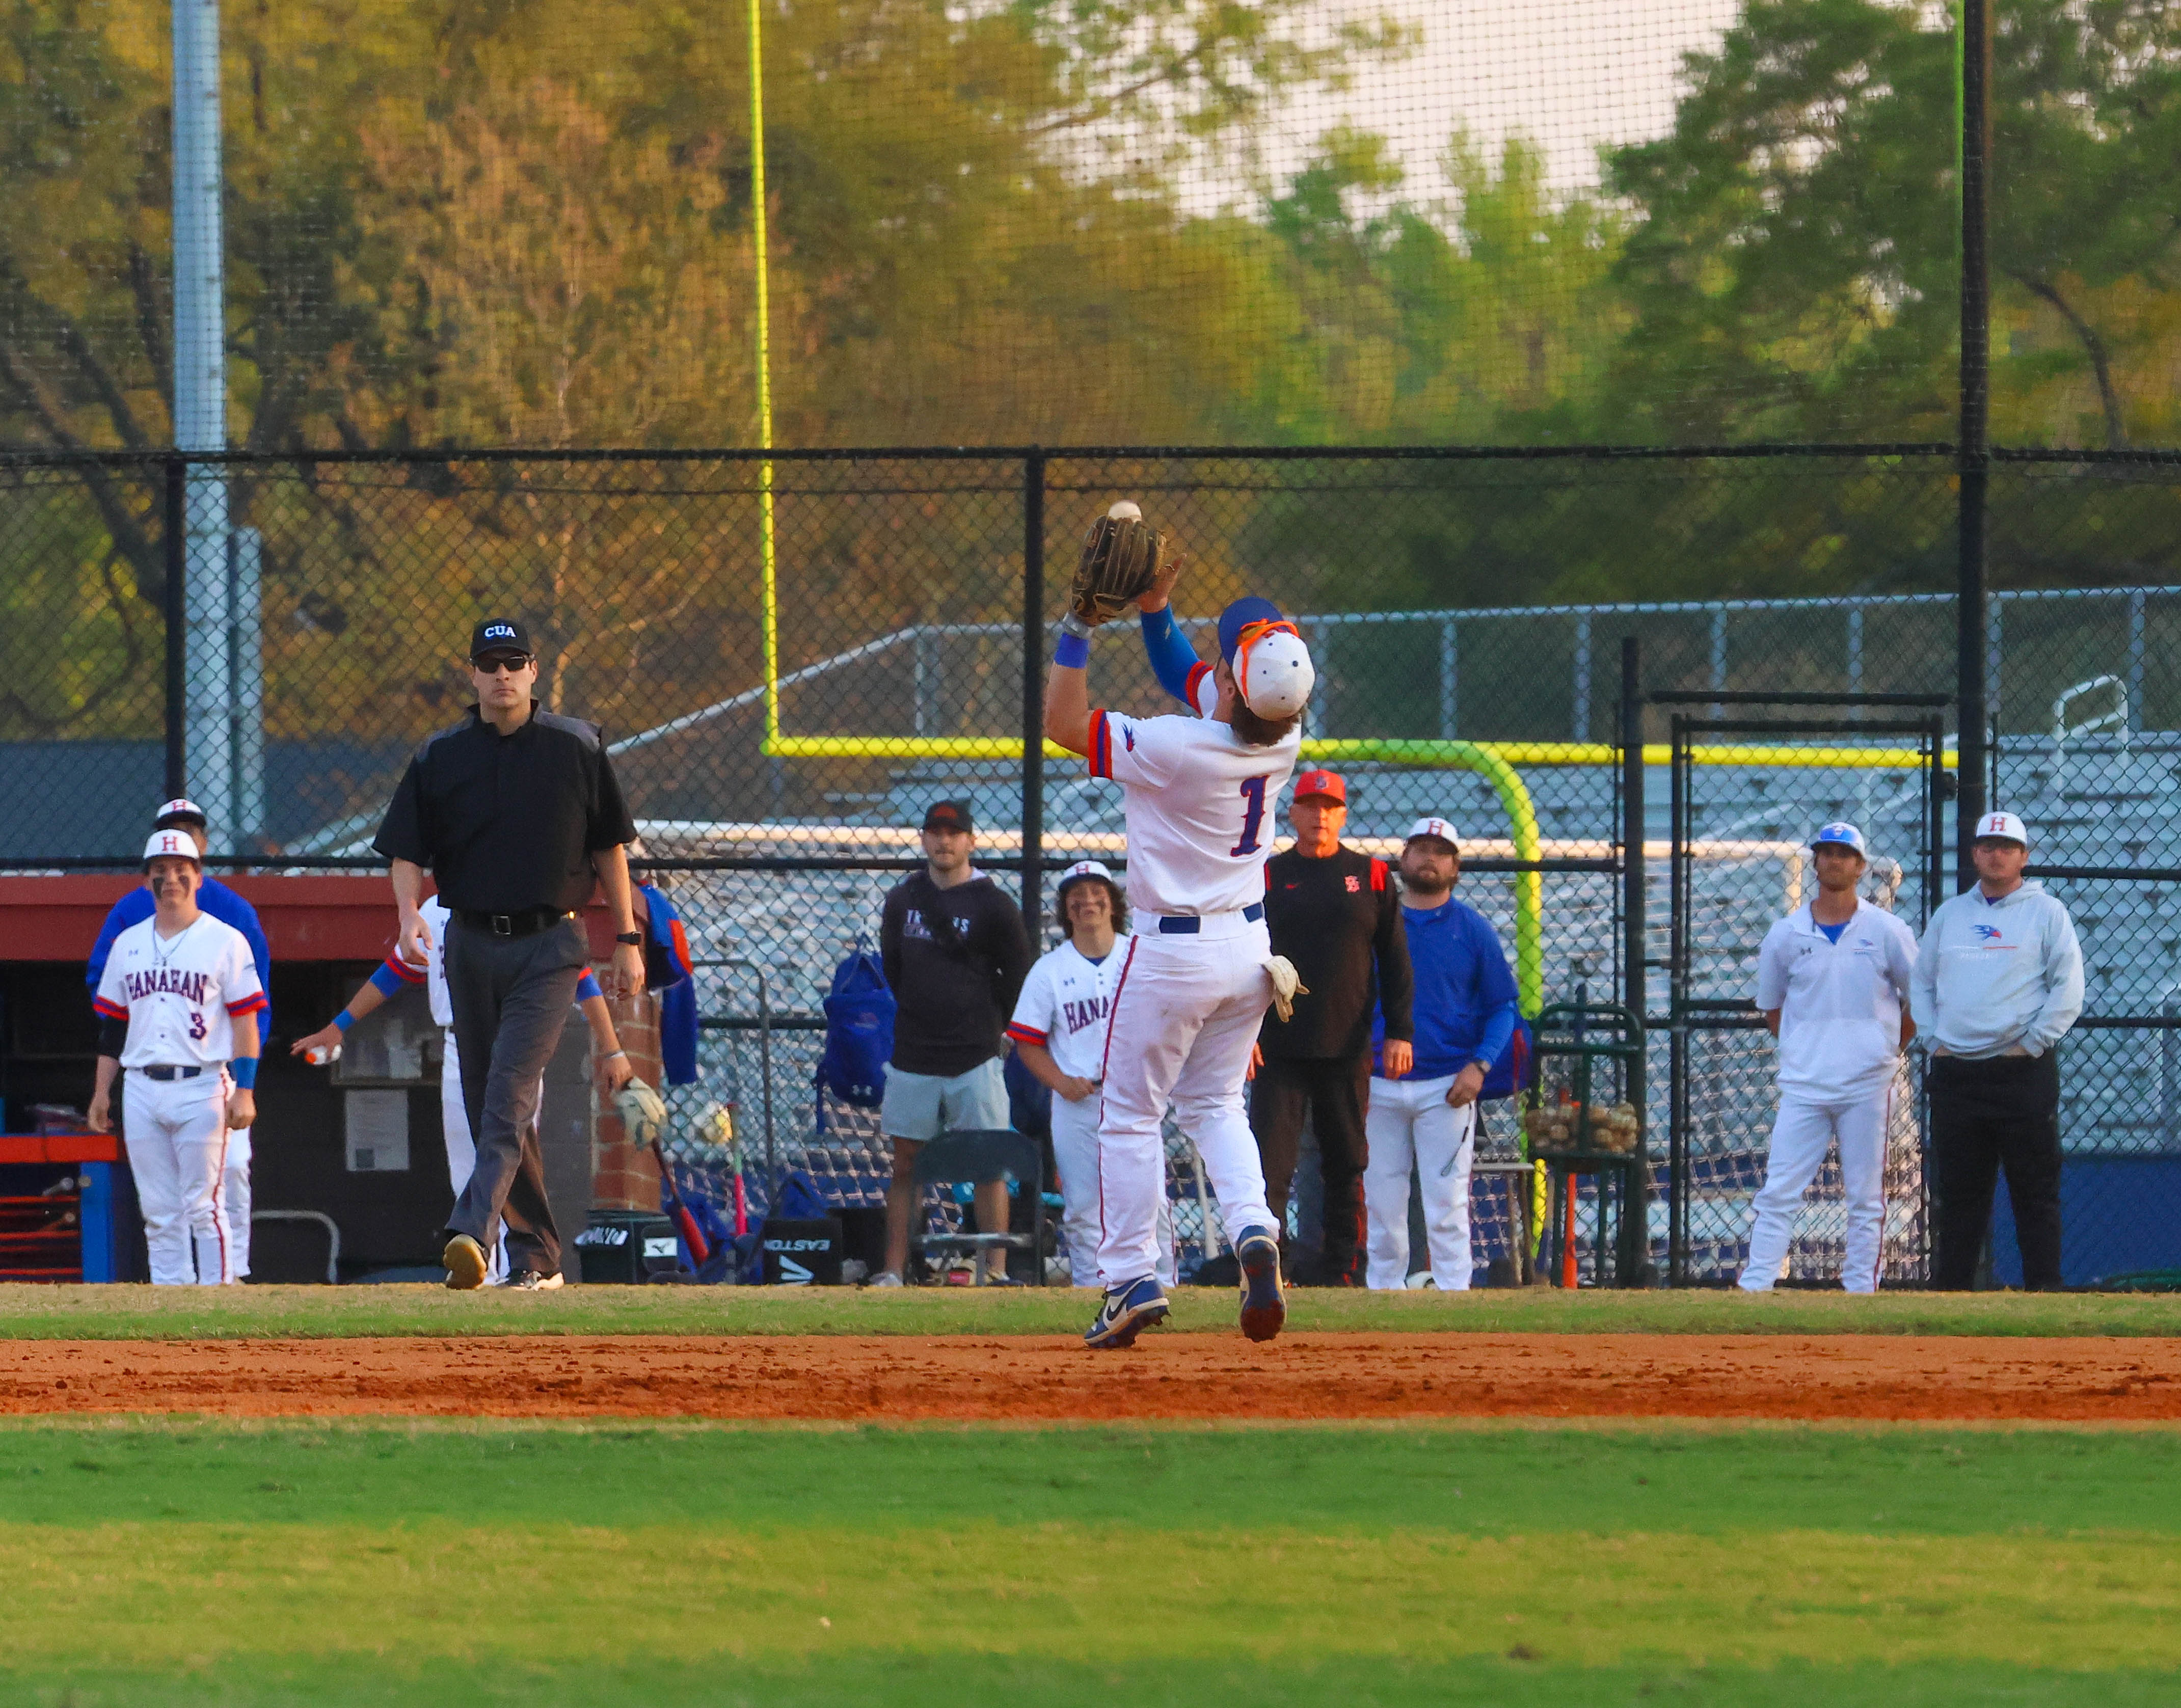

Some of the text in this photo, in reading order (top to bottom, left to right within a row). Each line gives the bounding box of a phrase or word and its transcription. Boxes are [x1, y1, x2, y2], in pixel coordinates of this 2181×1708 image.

[484, 625, 517, 638] CUA
[172, 801, 187, 811] H
[1230, 774, 1271, 857] 1
[1428, 820, 1444, 836] H
[1989, 816, 2006, 831] H
[162, 836, 178, 851] H
[190, 1012, 206, 1040] 3
